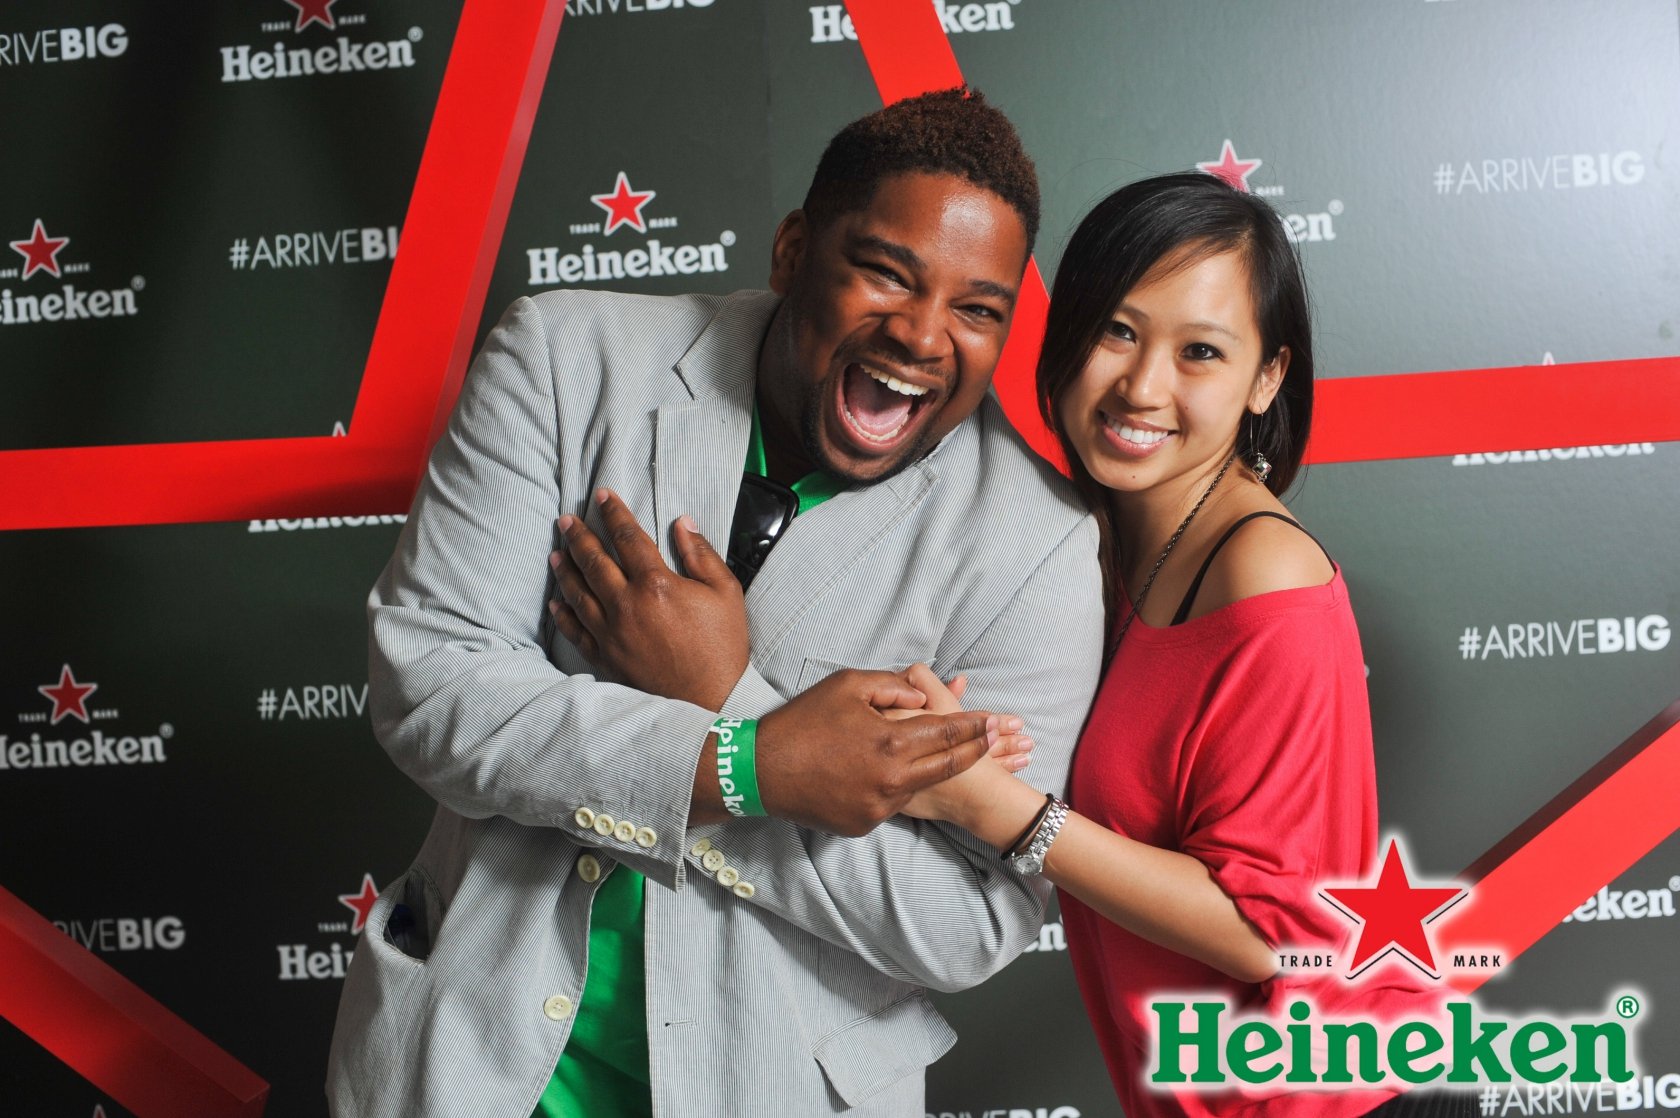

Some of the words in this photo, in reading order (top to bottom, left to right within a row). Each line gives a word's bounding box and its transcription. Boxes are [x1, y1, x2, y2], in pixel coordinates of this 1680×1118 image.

[1433, 150, 1646, 195] #ARRIVEBIG
[0, 284, 138, 325] ineken
[1459, 614, 1671, 661] #ARRIVEBIG
